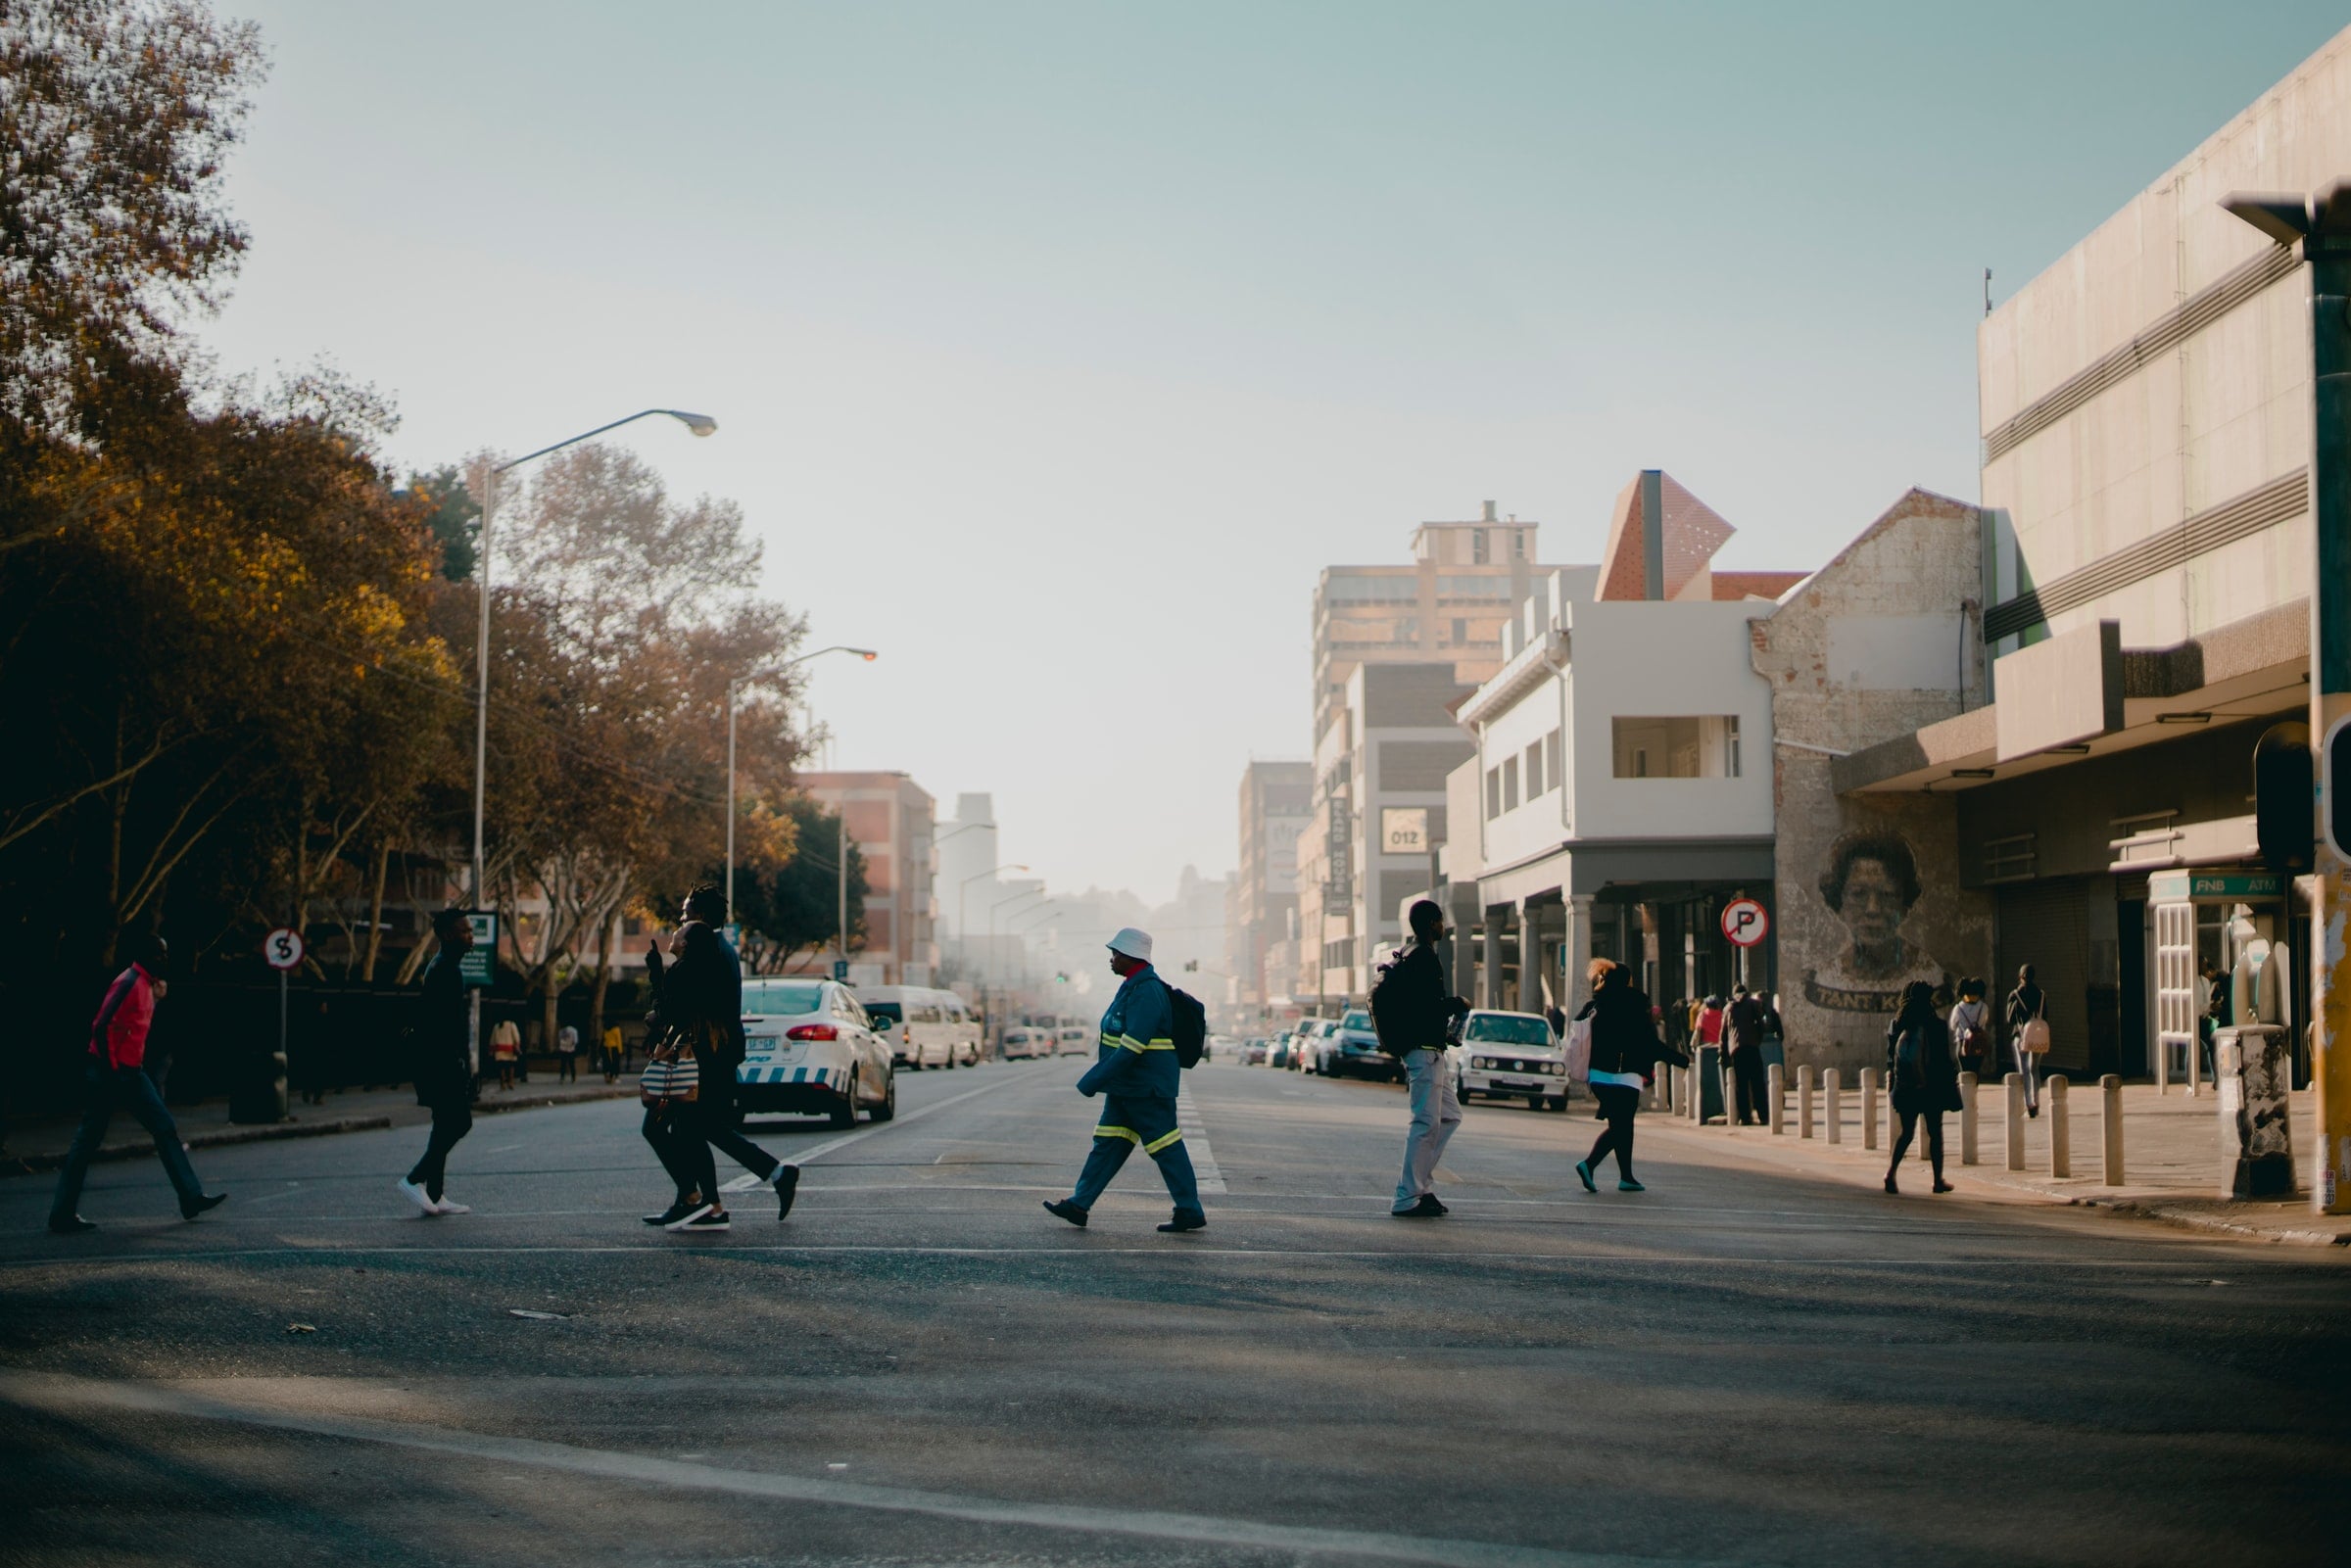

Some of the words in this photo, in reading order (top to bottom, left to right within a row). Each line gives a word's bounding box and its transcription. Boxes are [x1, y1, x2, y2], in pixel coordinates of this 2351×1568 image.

[1391, 831, 1418, 844] 012
[1333, 850, 1346, 893] HOUSE
[2195, 879, 2226, 892] FNB
[2247, 879, 2277, 891] ATM
[1737, 911, 1755, 934] P
[275, 937, 293, 959] S
[1817, 987, 1870, 1010] TANT
